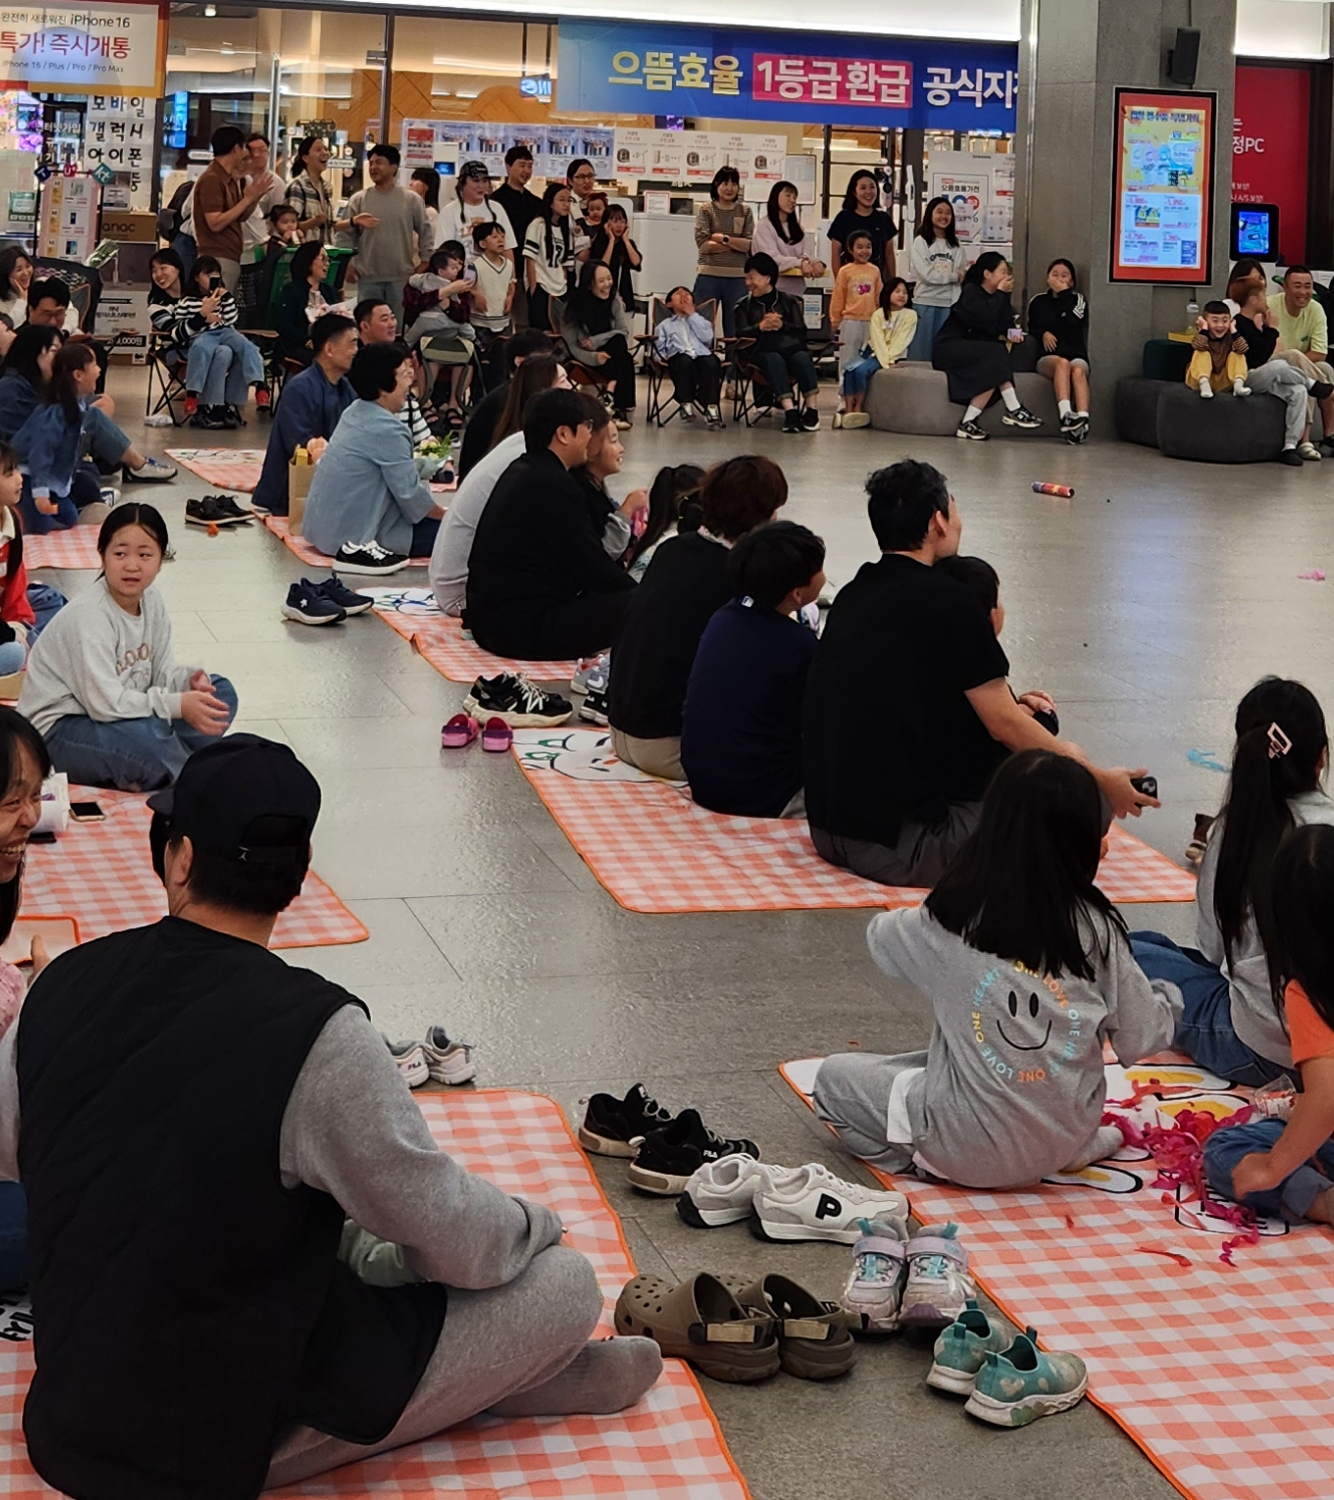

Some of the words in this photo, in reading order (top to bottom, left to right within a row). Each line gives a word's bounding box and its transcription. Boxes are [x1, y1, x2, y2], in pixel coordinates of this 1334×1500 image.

[70, 13, 114, 28] iPhone
[115, 17, 131, 28] 16
[49, 33, 131, 60] 즉시개통
[31, 61, 42, 70] 16
[48, 62, 65, 71] Plus
[72, 63, 87, 72] Pro
[93, 64, 107, 73] Pro
[108, 65, 124, 73] Max
[608, 51, 744, 96] 으뜸효율
[756, 60, 842, 102] 1등급
[845, 61, 911, 104] 환급
[922, 66, 1018, 109] 공식지
[91, 95, 146, 118] 모바일
[89, 121, 144, 143] 갤럭시
[88, 148, 143, 168] 아이폰
[95, 166, 111, 182] kt
[972, 1011, 985, 1043] ONE
[980, 1047, 1013, 1080] LOVE
[1018, 1068, 1046, 1083] ONE
[815, 1192, 842, 1220] P
